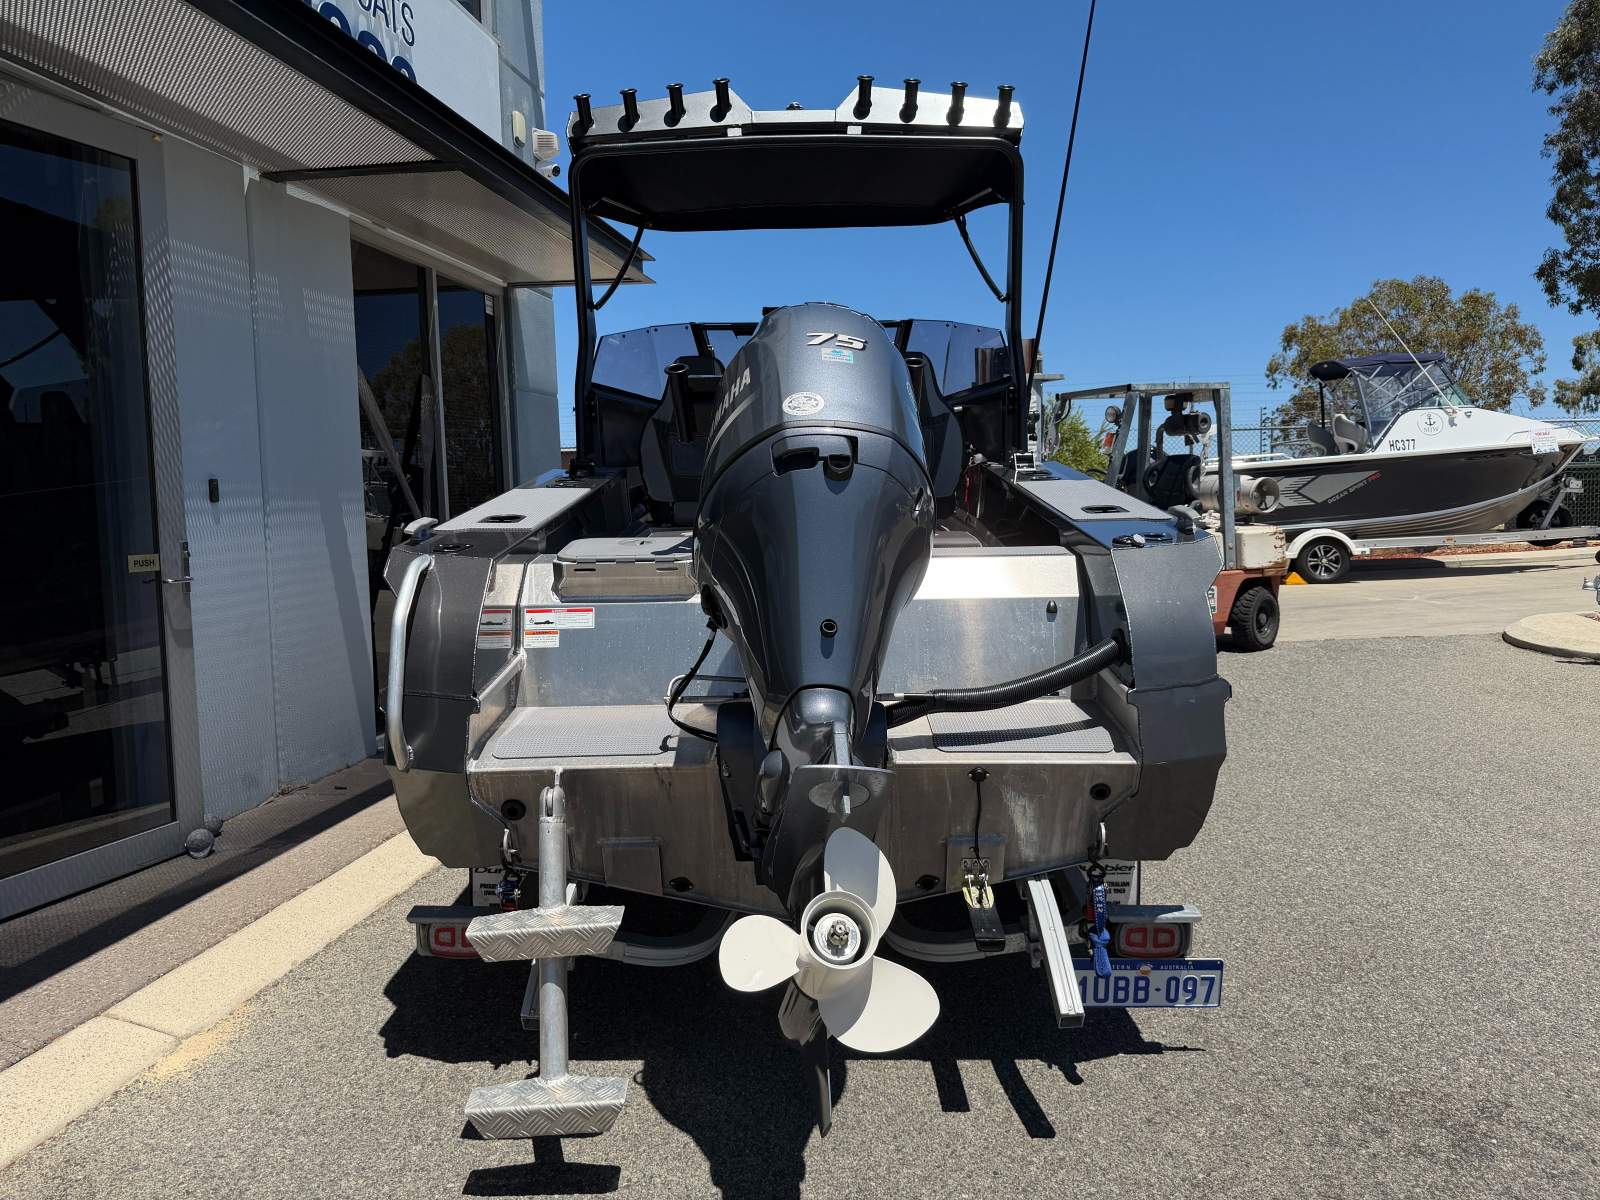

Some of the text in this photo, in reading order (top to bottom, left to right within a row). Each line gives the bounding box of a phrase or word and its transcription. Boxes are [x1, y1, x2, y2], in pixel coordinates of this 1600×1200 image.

[358, 0, 415, 47] ATS
[806, 333, 867, 350] 75
[1388, 439, 1416, 452] HC377
[1327, 490, 1348, 504] OCEAN
[133, 559, 155, 567] PUSH
